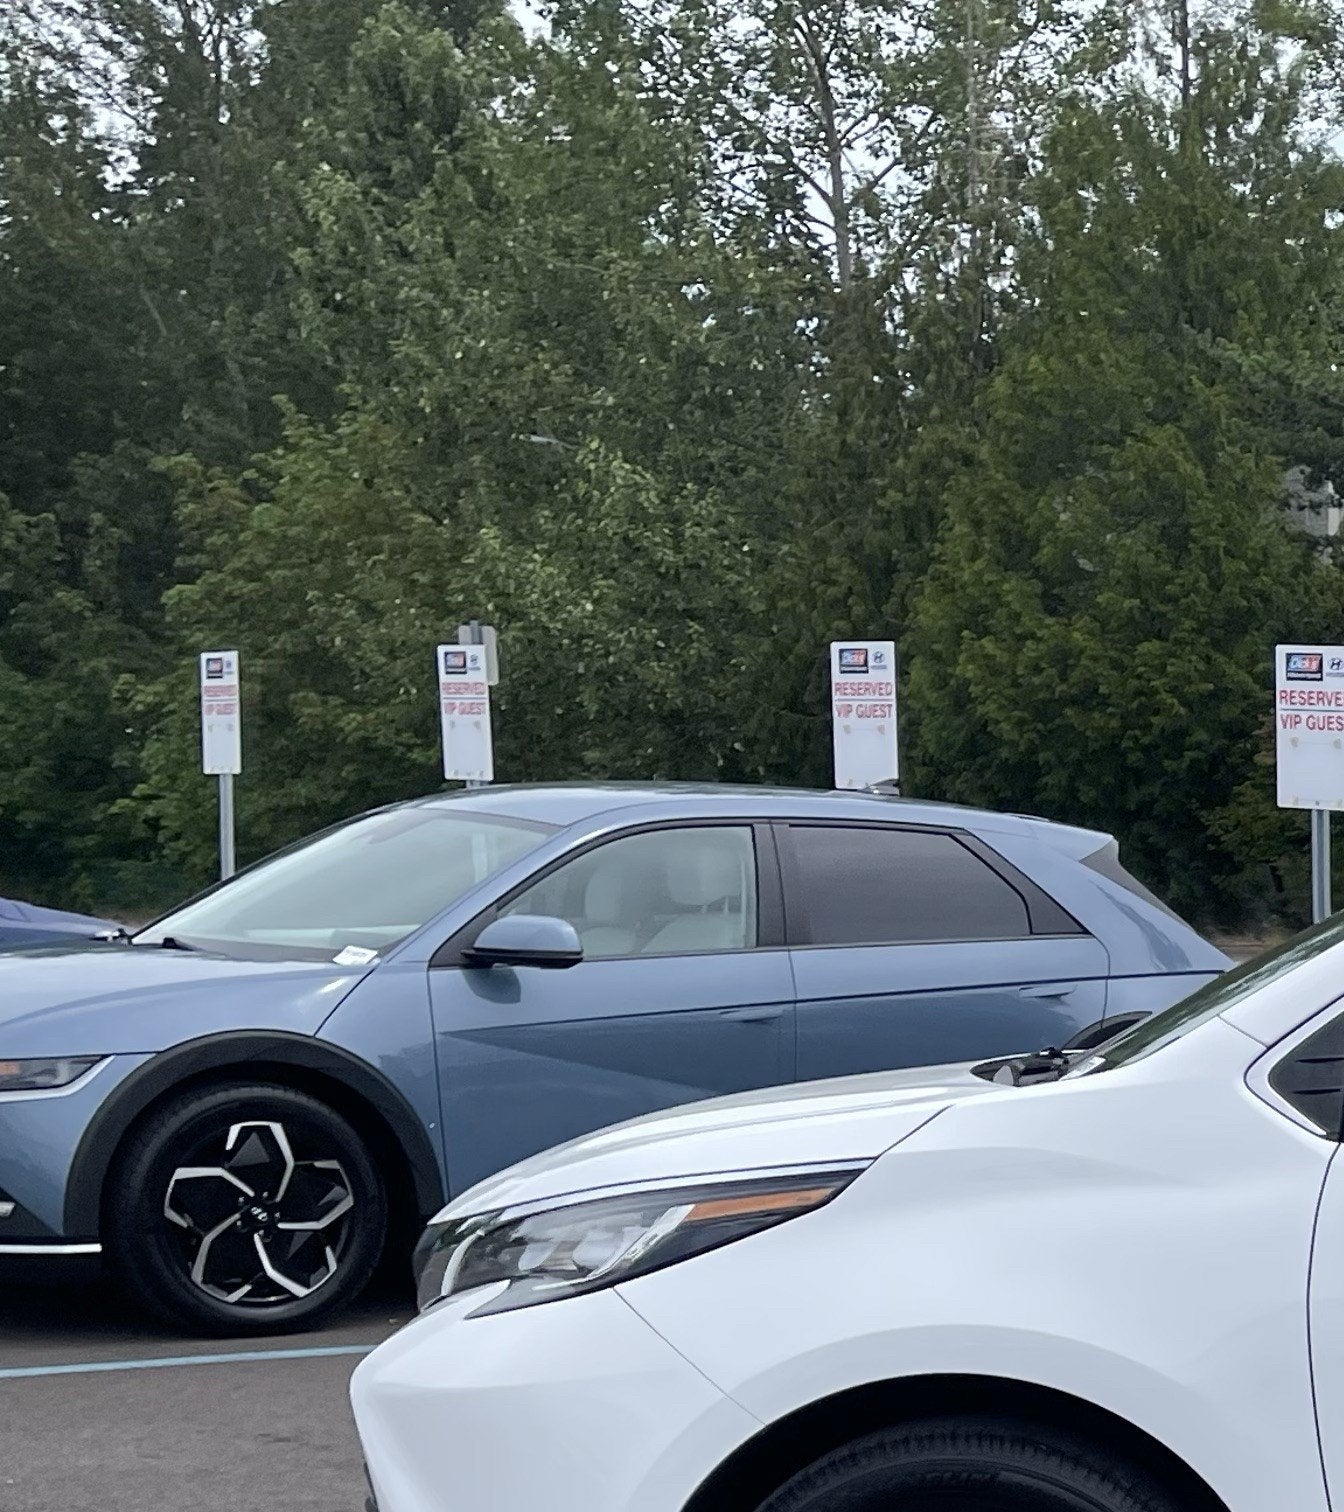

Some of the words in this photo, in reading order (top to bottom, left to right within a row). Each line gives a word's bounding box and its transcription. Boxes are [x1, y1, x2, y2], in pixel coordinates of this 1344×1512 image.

[834, 682, 893, 696] RESERVED
[835, 704, 853, 718] VIP
[856, 703, 893, 718] GUEST
[1280, 713, 1302, 730] VIP
